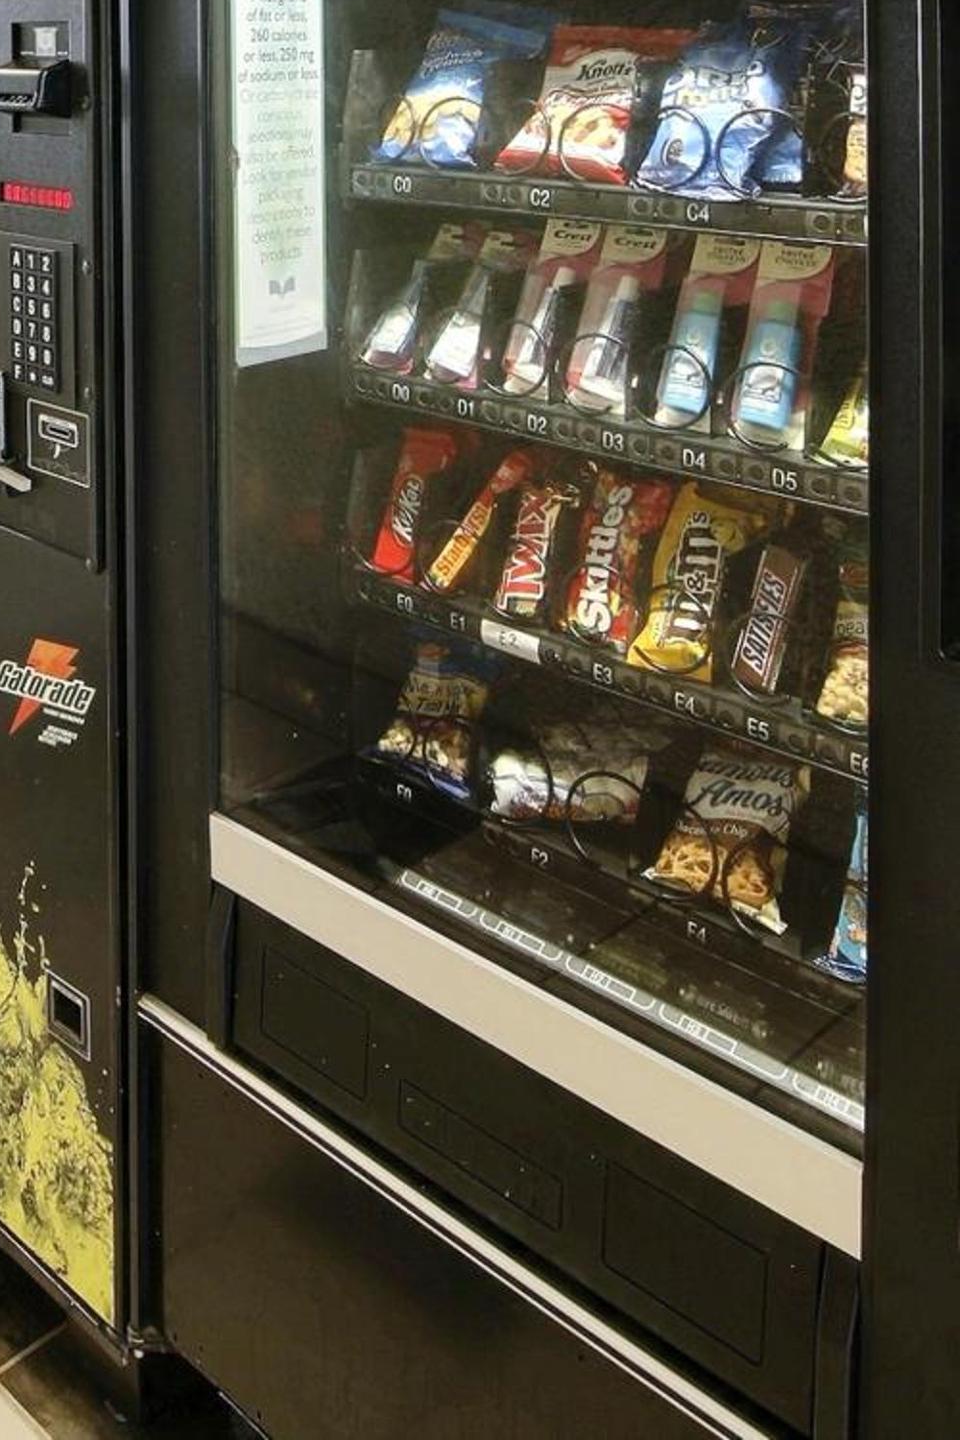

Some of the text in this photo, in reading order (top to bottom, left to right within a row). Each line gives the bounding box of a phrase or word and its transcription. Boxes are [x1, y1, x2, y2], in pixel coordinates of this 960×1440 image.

[394, 175, 709, 223] C0 C2 C4
[393, 383, 798, 492] D0 D1 D2 D3 D4 D5
[742, 570, 786, 673] SATISFIES
[593, 663, 613, 685] E3
[674, 692, 695, 713] E4
[746, 718, 770, 742] E5
[687, 780, 783, 817] Amos
